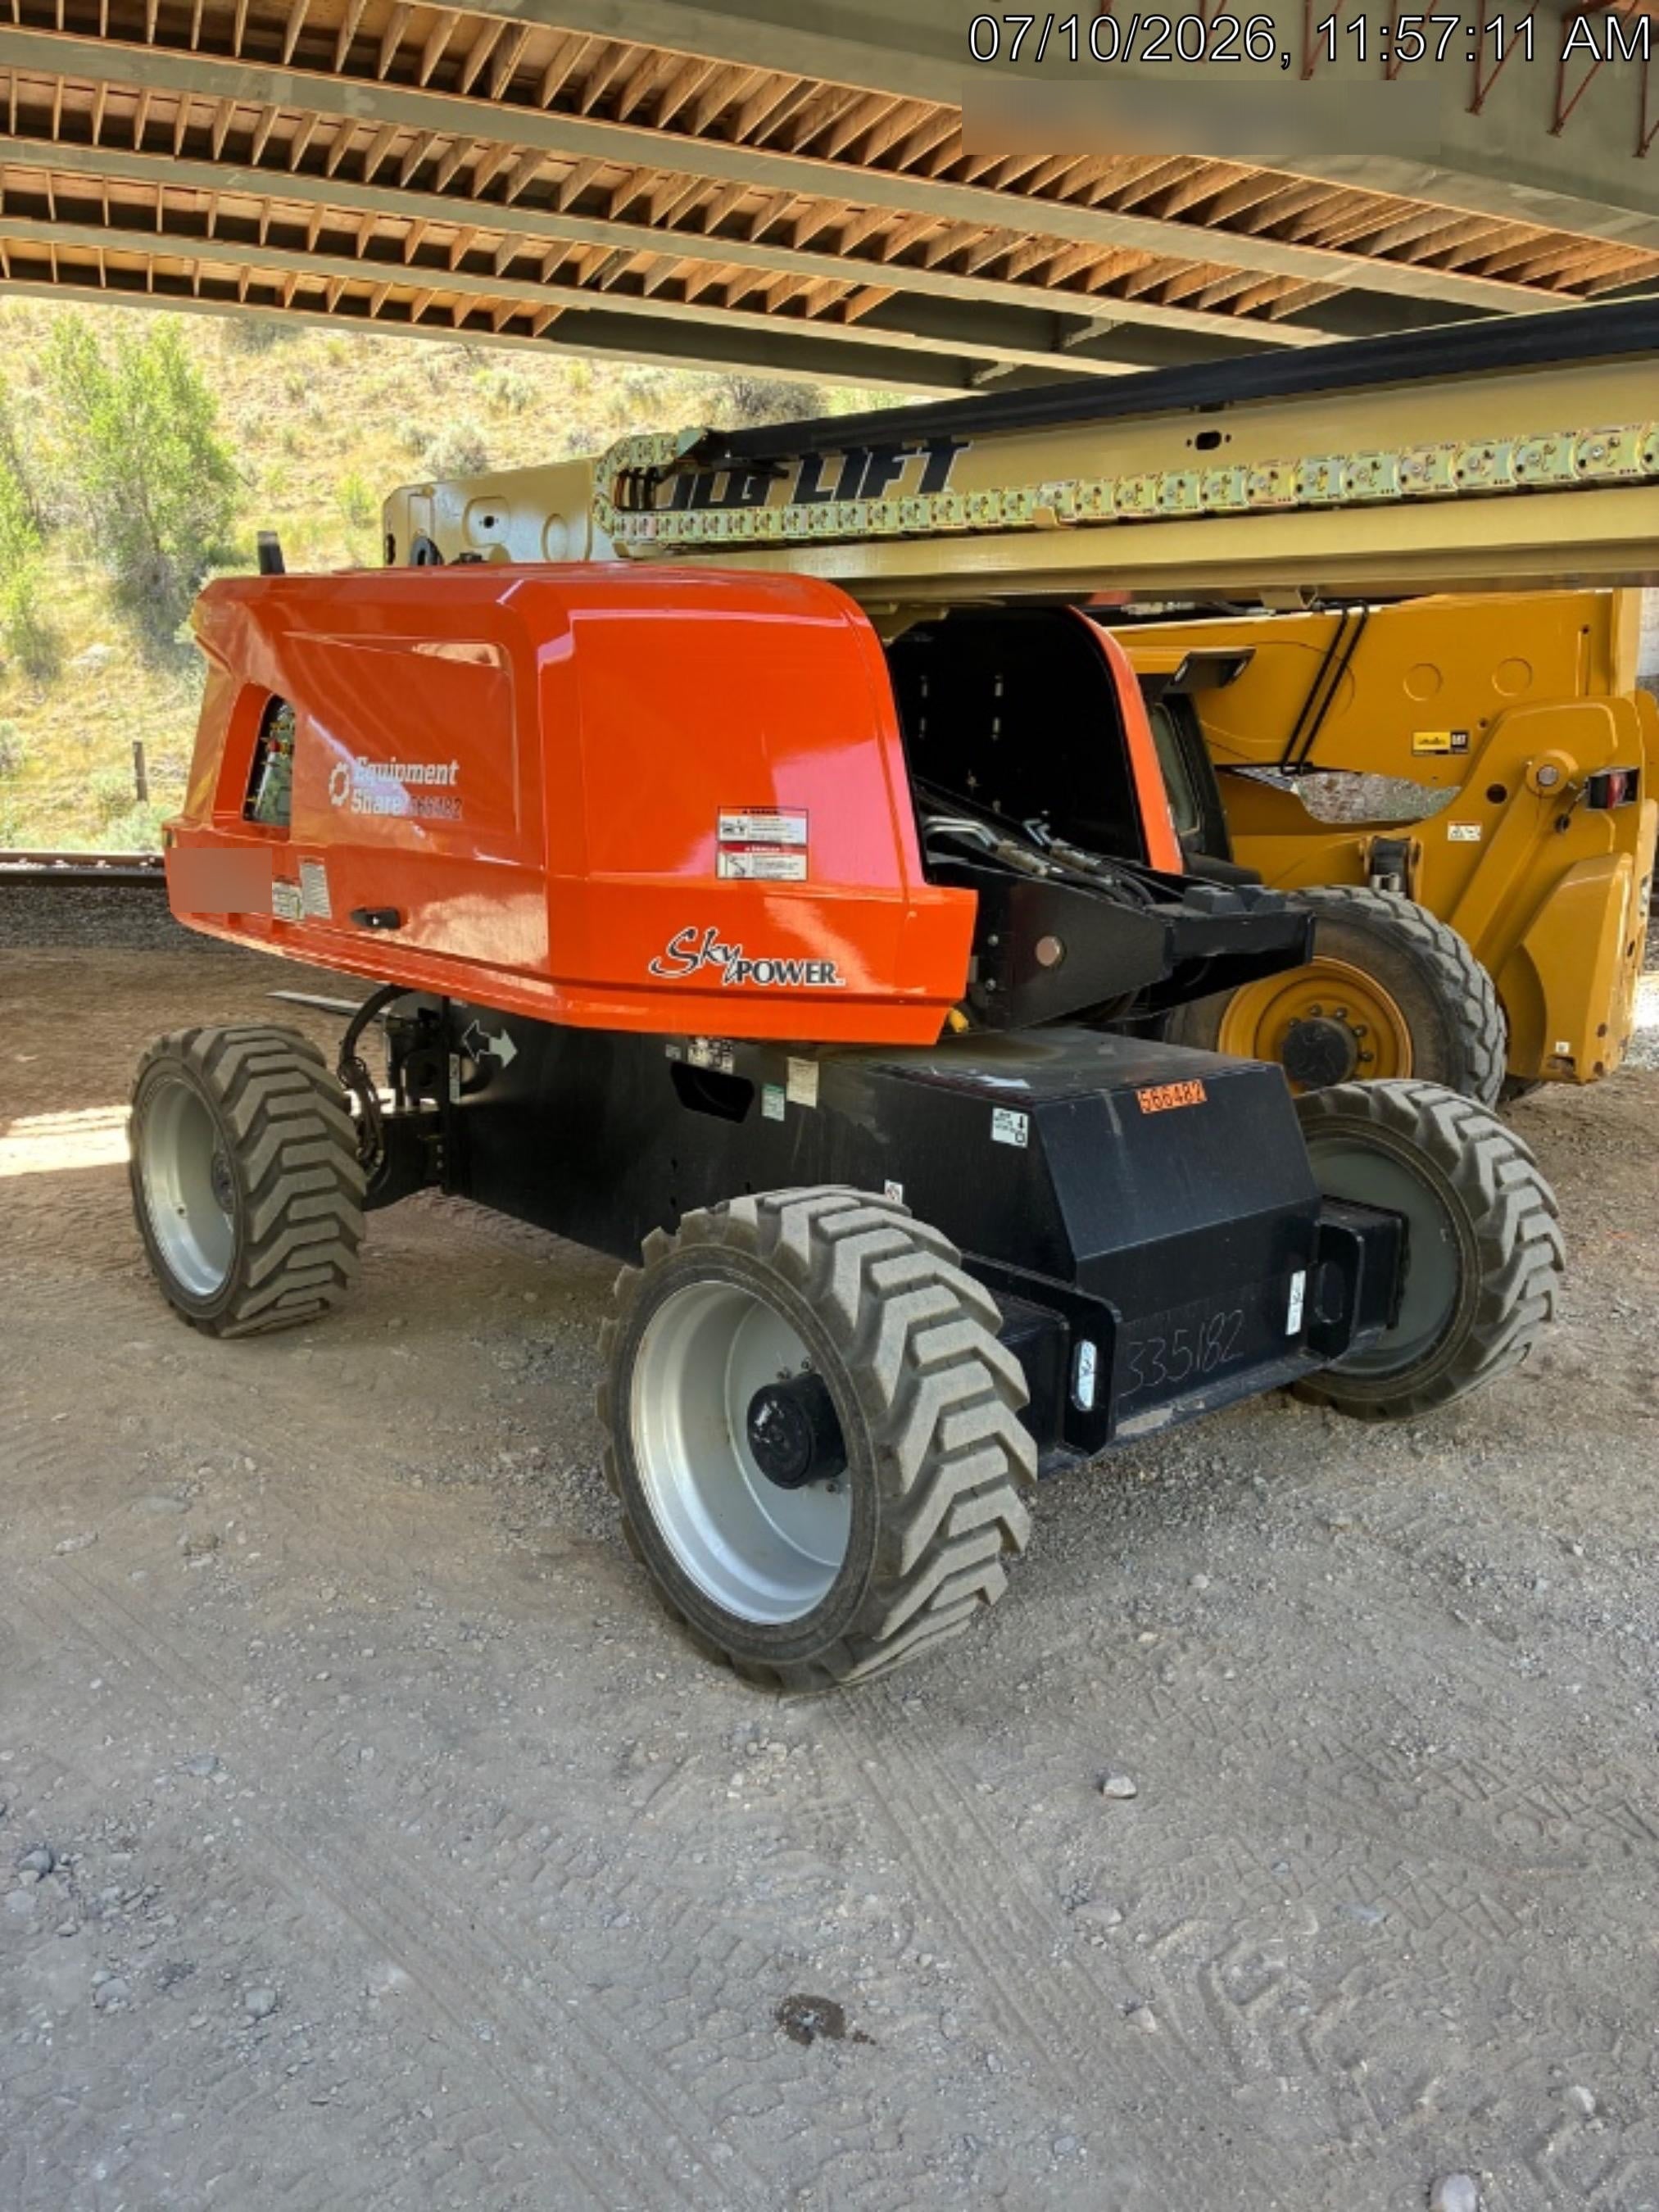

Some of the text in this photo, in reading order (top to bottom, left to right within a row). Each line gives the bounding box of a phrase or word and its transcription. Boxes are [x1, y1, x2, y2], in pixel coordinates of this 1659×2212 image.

[790, 437, 973, 504] LIFT
[351, 756, 460, 787] Equipment
[351, 788, 403, 816] Share
[648, 927, 837, 986] Sky POWER
[1139, 1080, 1203, 1112] 566482
[1118, 1309, 1245, 1398] 335182
